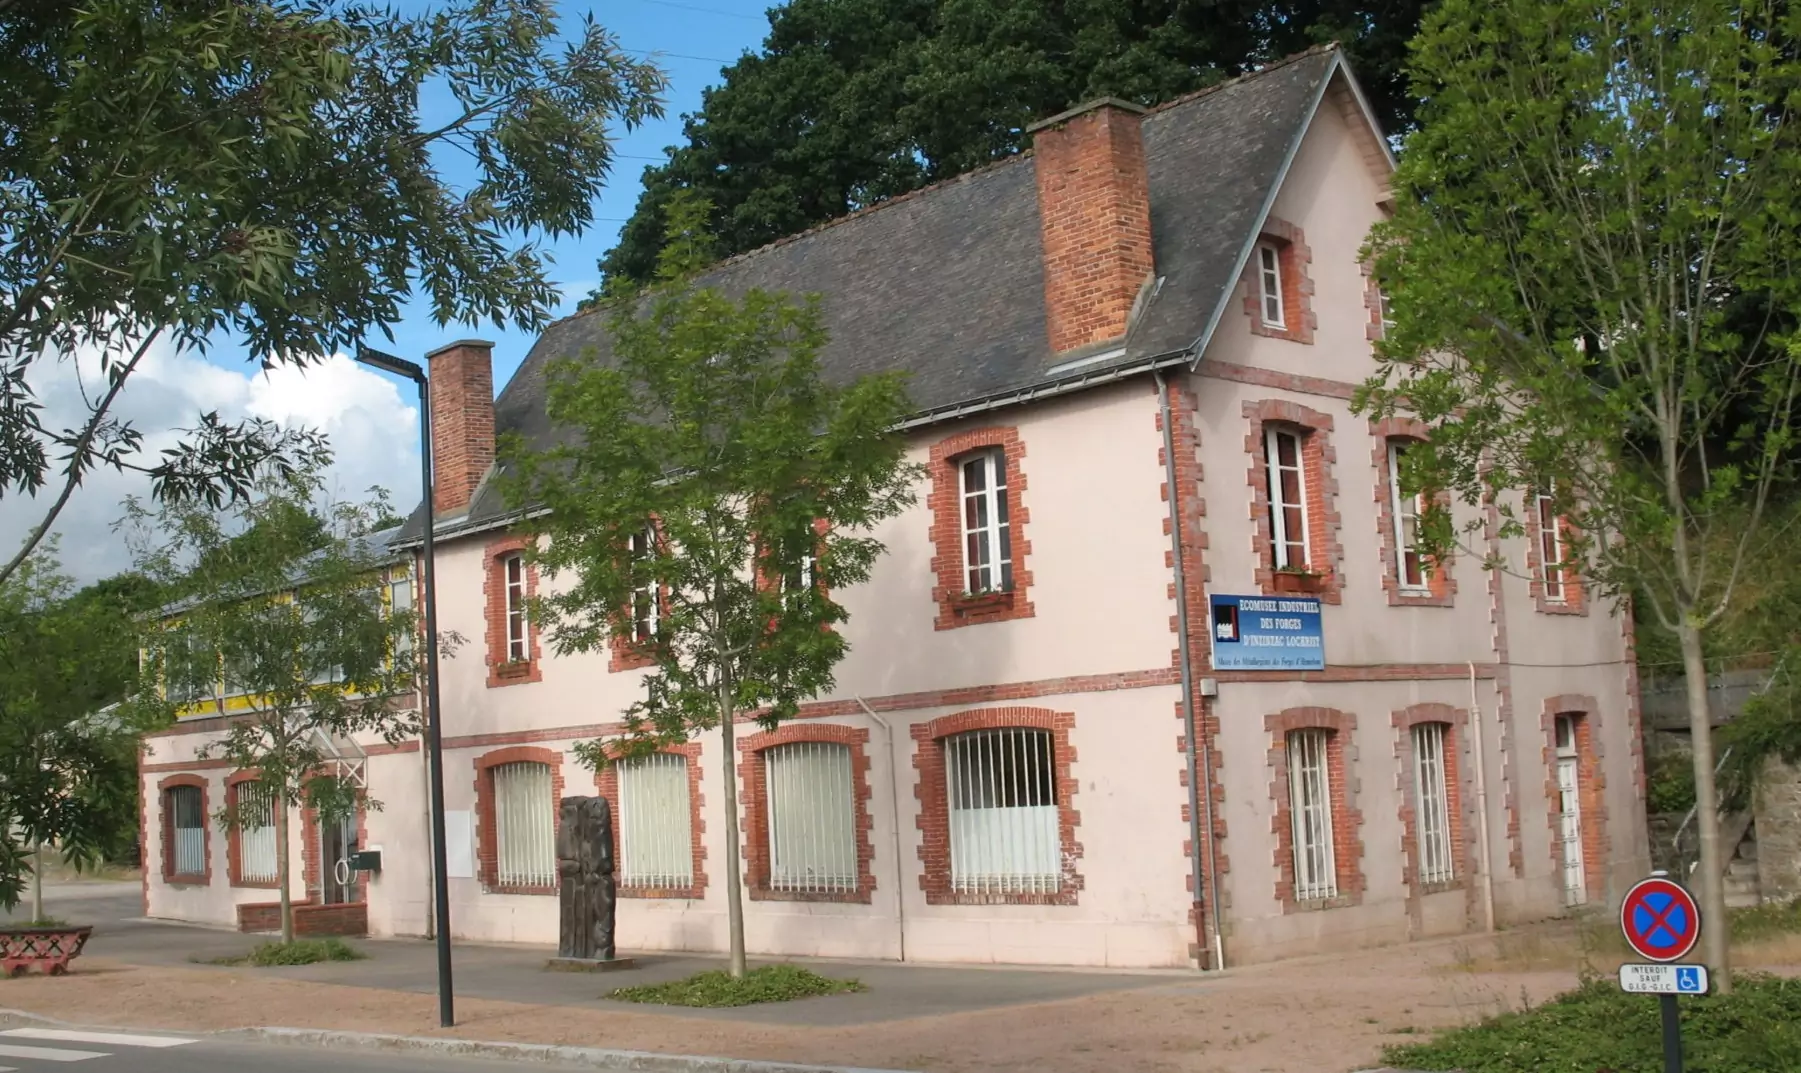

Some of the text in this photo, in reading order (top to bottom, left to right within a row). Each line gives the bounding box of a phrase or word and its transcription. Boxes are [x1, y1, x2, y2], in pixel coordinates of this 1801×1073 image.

[1240, 600, 1320, 613] ECOMUSEE INDUSTRIEL
[1260, 618, 1302, 630] DES FORGES
[1631, 966, 1667, 974] INTERDIT
